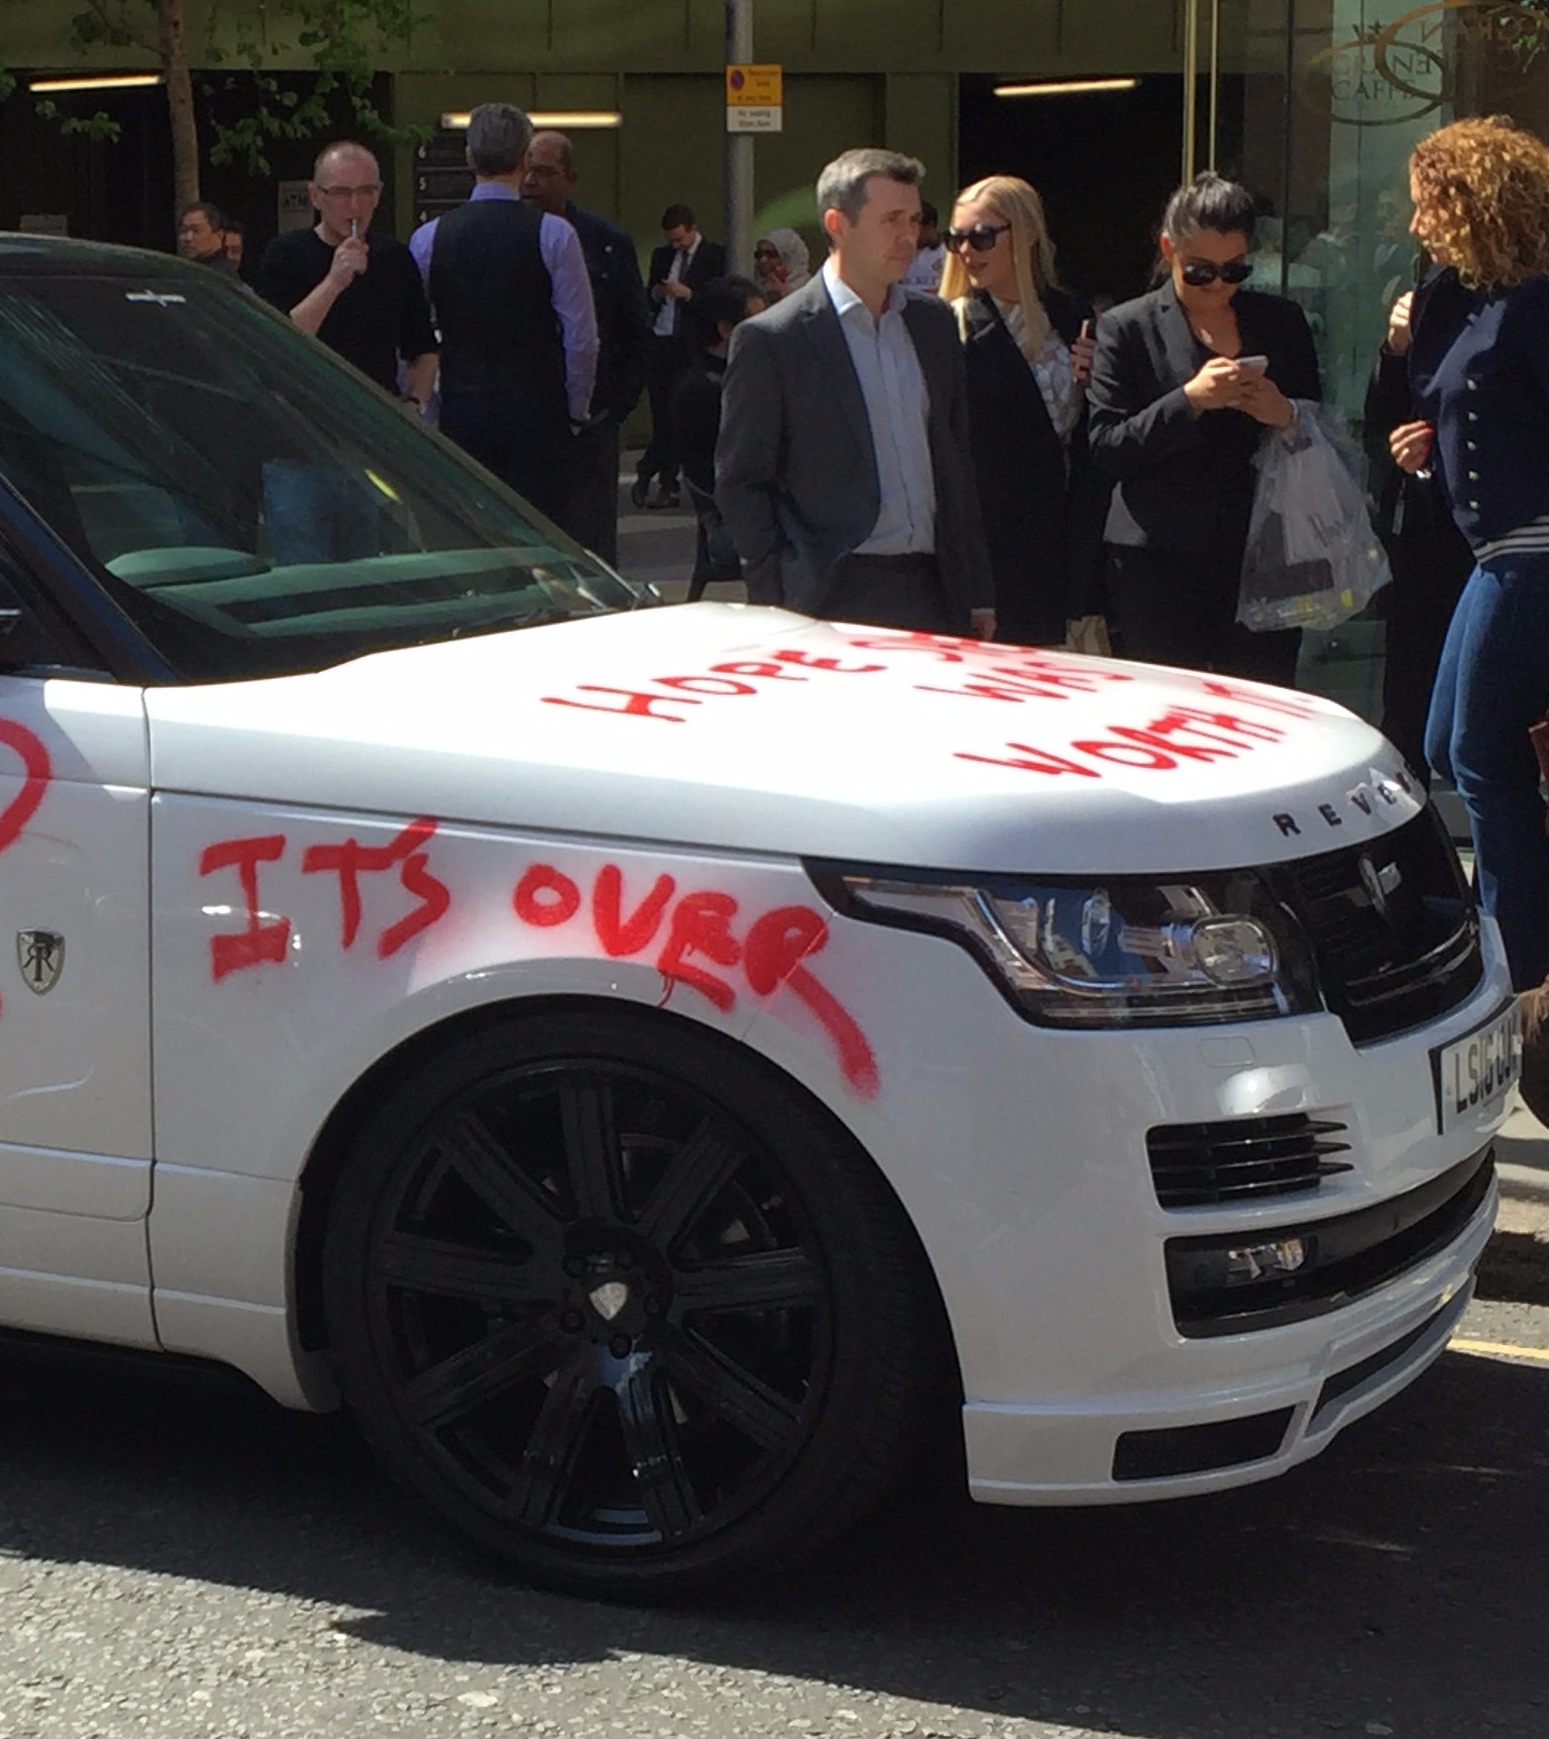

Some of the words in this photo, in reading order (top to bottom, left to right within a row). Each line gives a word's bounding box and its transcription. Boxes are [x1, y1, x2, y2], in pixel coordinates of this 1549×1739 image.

[540, 649, 888, 723] HOPE
[953, 703, 1287, 779] WORTH
[1272, 760, 1421, 837] REVE
[511, 862, 880, 1098] OVER
